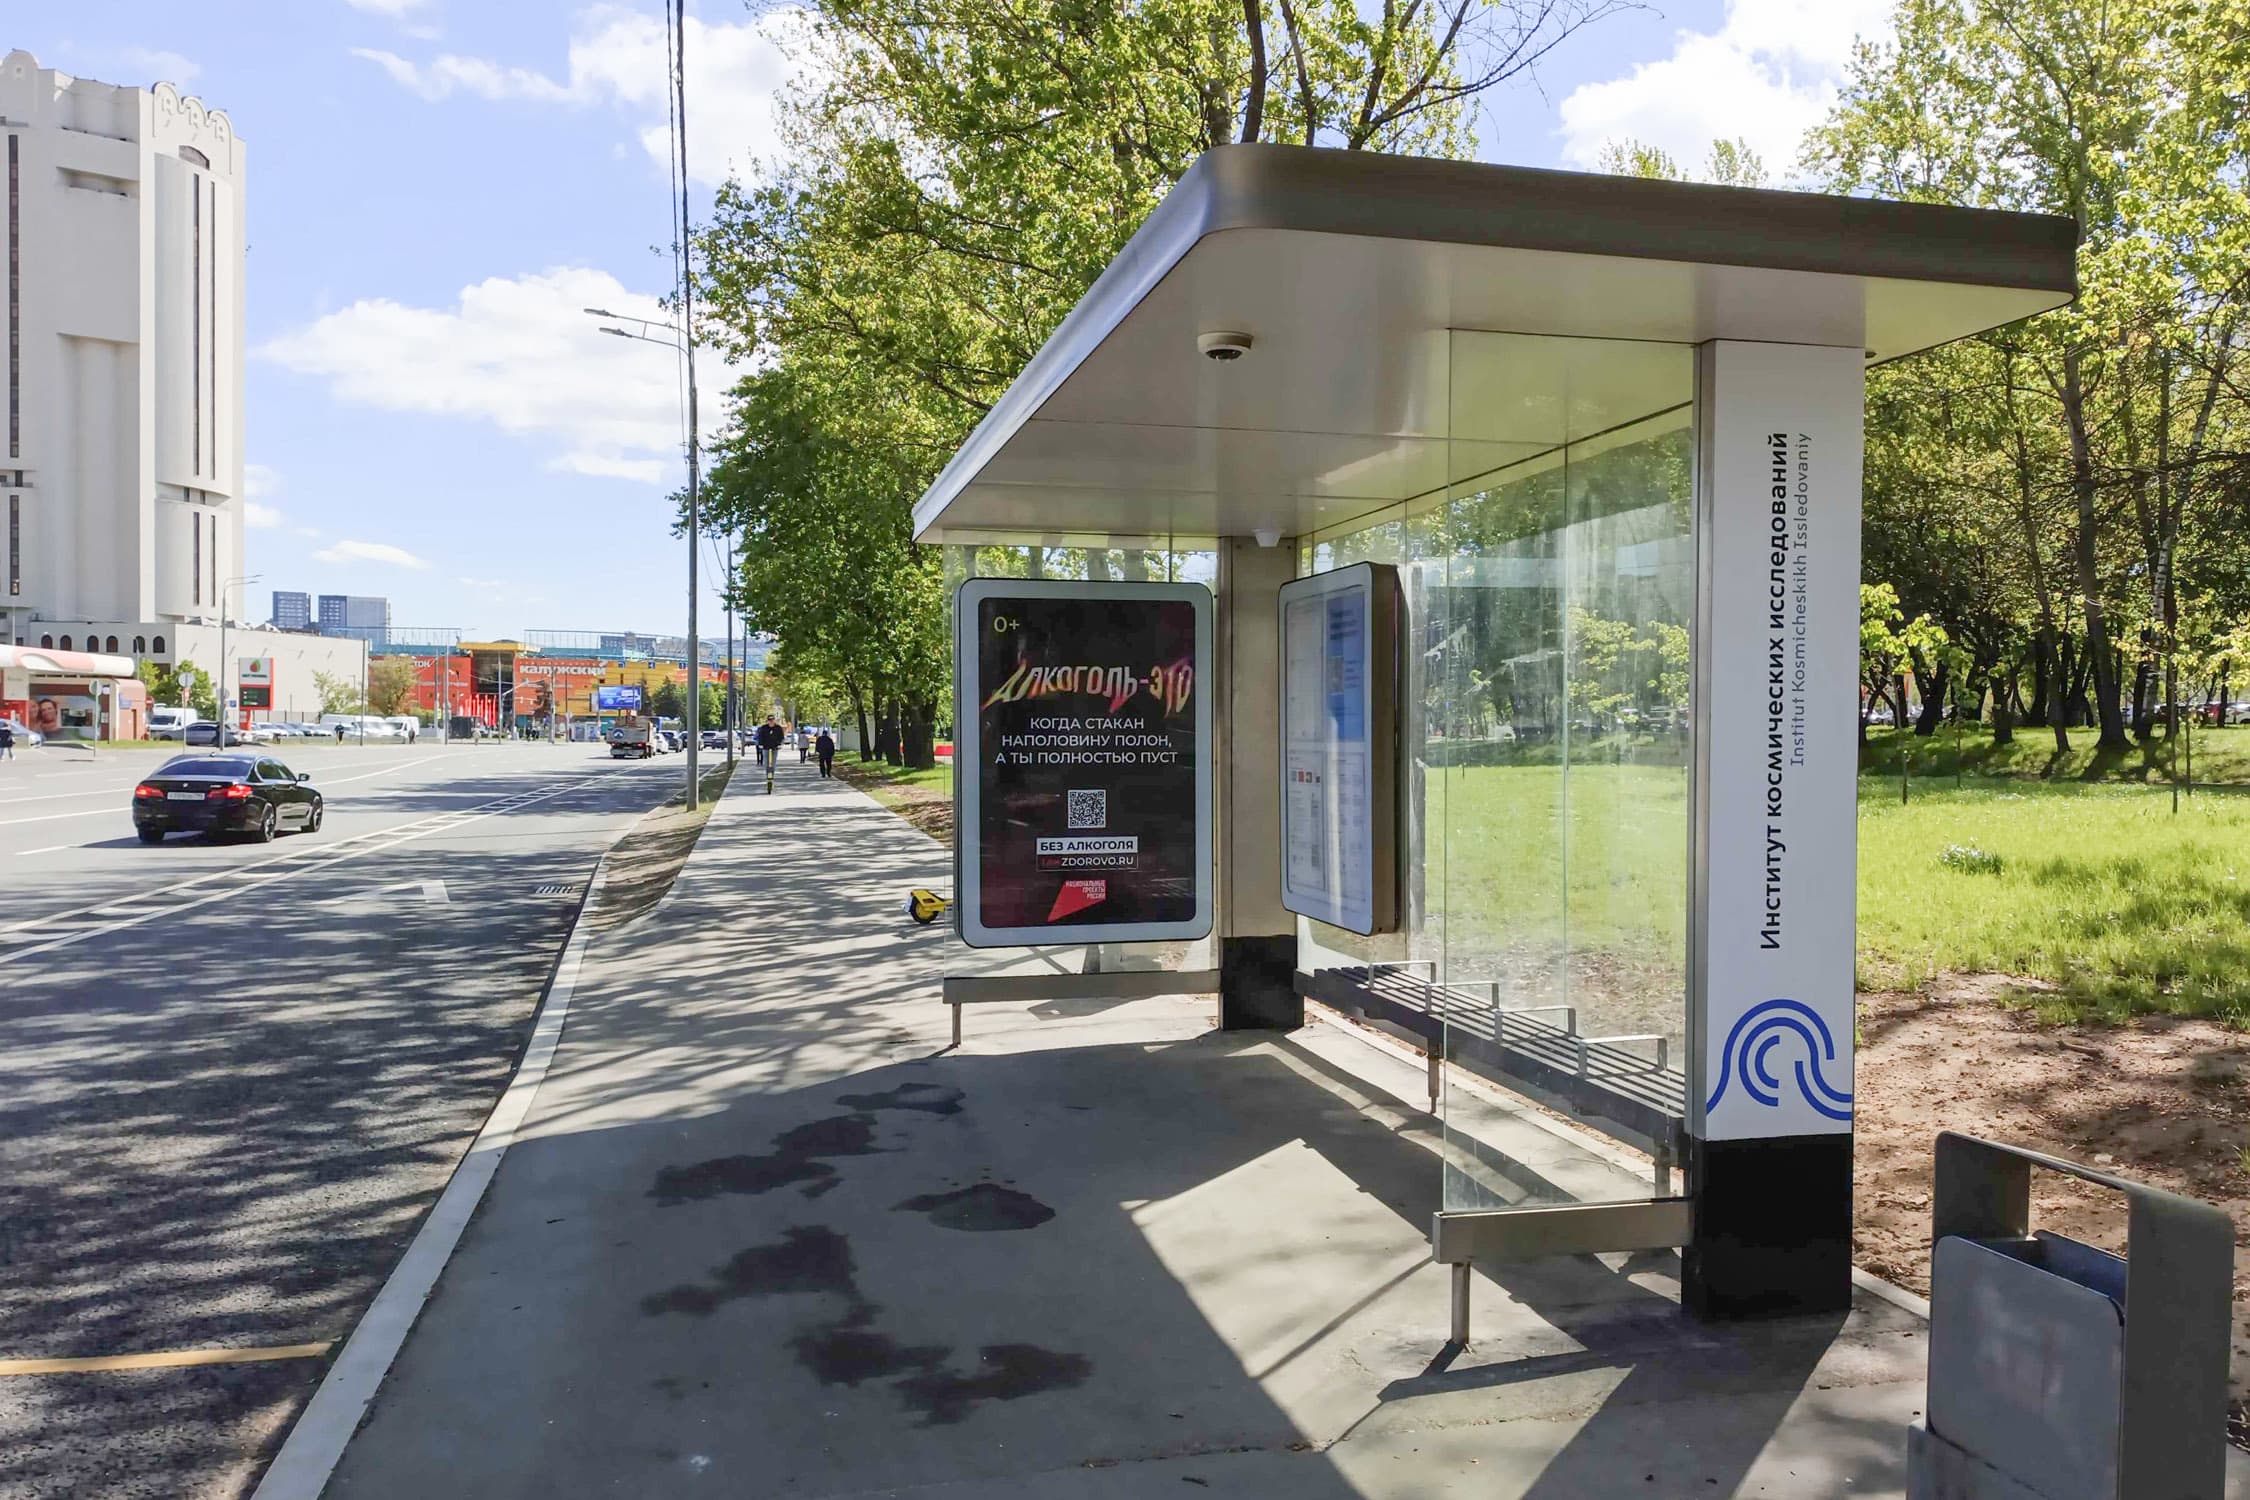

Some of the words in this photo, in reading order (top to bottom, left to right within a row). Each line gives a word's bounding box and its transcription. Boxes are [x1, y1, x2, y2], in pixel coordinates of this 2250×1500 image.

[1793, 432, 1812, 549] Issledovaniy
[1768, 432, 1789, 629] исследований
[993, 616, 1020, 633] 0+
[1791, 555, 1807, 692] Kosmicheskikh
[995, 752, 1006, 764] А
[1010, 752, 1033, 764] ТЫ
[1038, 751, 1136, 764] ПОЛНОСТЬЮ
[1140, 750, 1178, 763] ПУСТ
[1002, 734, 1110, 747] НАПОЛОВИНУ
[1115, 734, 1172, 748] ПОЛОН,
[1030, 717, 1081, 730] КОГДА
[1085, 717, 1144, 730] СТАКАН
[1767, 637, 1784, 817] космических
[1790, 697, 1805, 766] Institut
[1040, 842, 1063, 851] БЕЗ
[1067, 840, 1134, 851] АЛКОГОЛЯ
[1761, 823, 1786, 949] Институт
